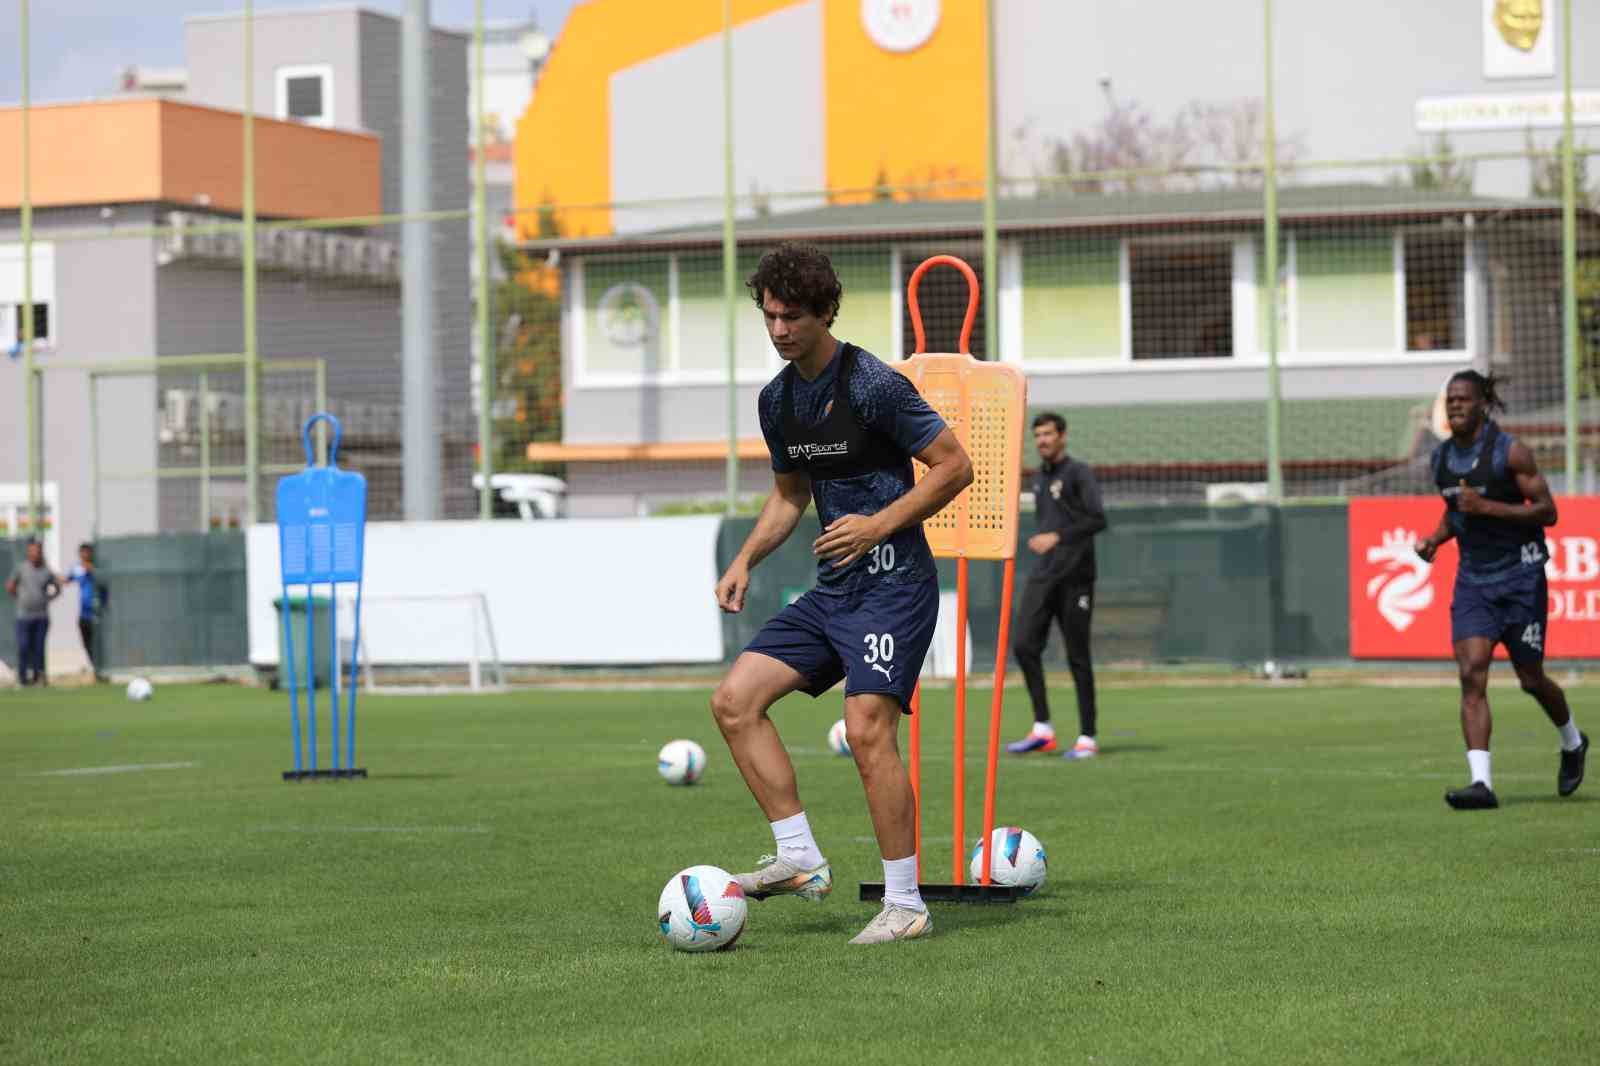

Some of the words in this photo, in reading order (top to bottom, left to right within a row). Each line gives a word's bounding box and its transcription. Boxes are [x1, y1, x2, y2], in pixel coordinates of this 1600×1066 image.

[867, 543, 895, 574] 30
[1520, 541, 1543, 564] 42
[1521, 622, 1542, 644] 42
[863, 633, 894, 663] 30
